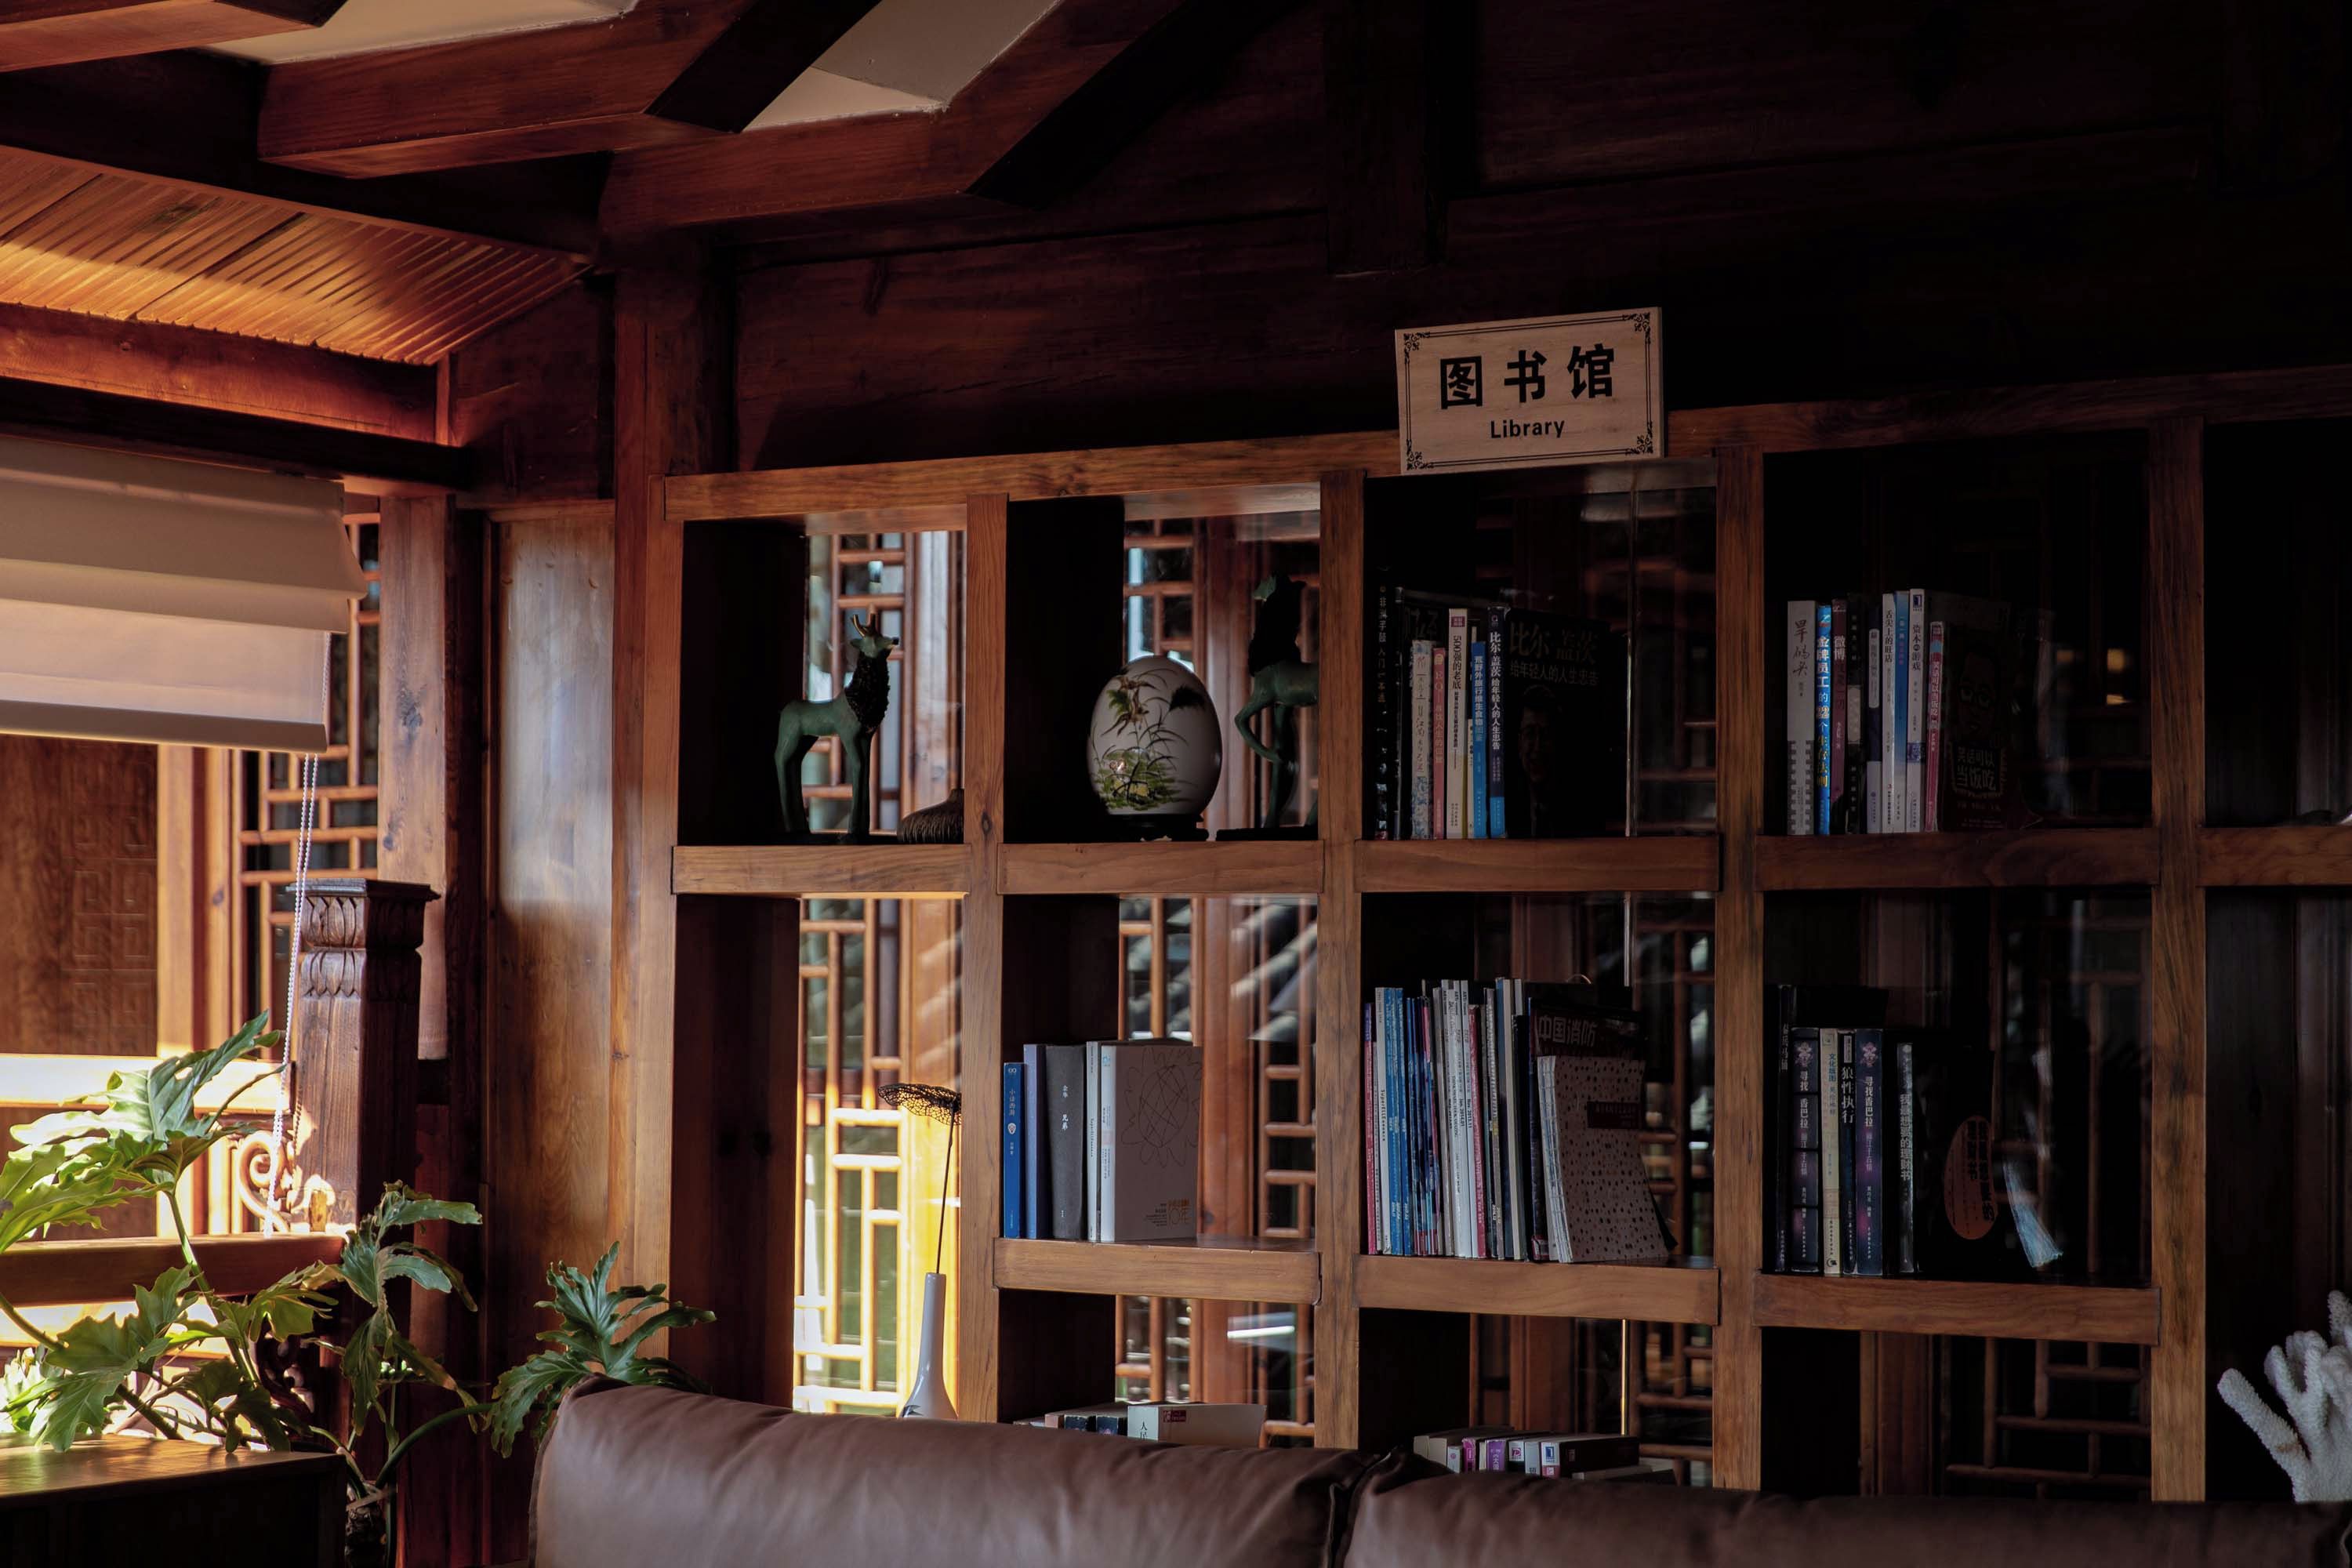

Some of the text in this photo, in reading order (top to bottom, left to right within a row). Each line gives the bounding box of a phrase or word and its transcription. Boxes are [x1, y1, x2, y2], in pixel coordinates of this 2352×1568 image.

[1440, 343, 1614, 409] 图书馆
[1490, 419, 1565, 439] Library
[1793, 619, 1809, 677] 旱码头
[1885, 609, 1893, 663] 舌尖上的旺店
[1538, 1014, 1596, 1047] 中国消防
[1842, 1065, 1854, 1123] 狼性执行
[1865, 1076, 1874, 1127] 寻找香巴拉
[1062, 1113, 1069, 1131] 兄弟
